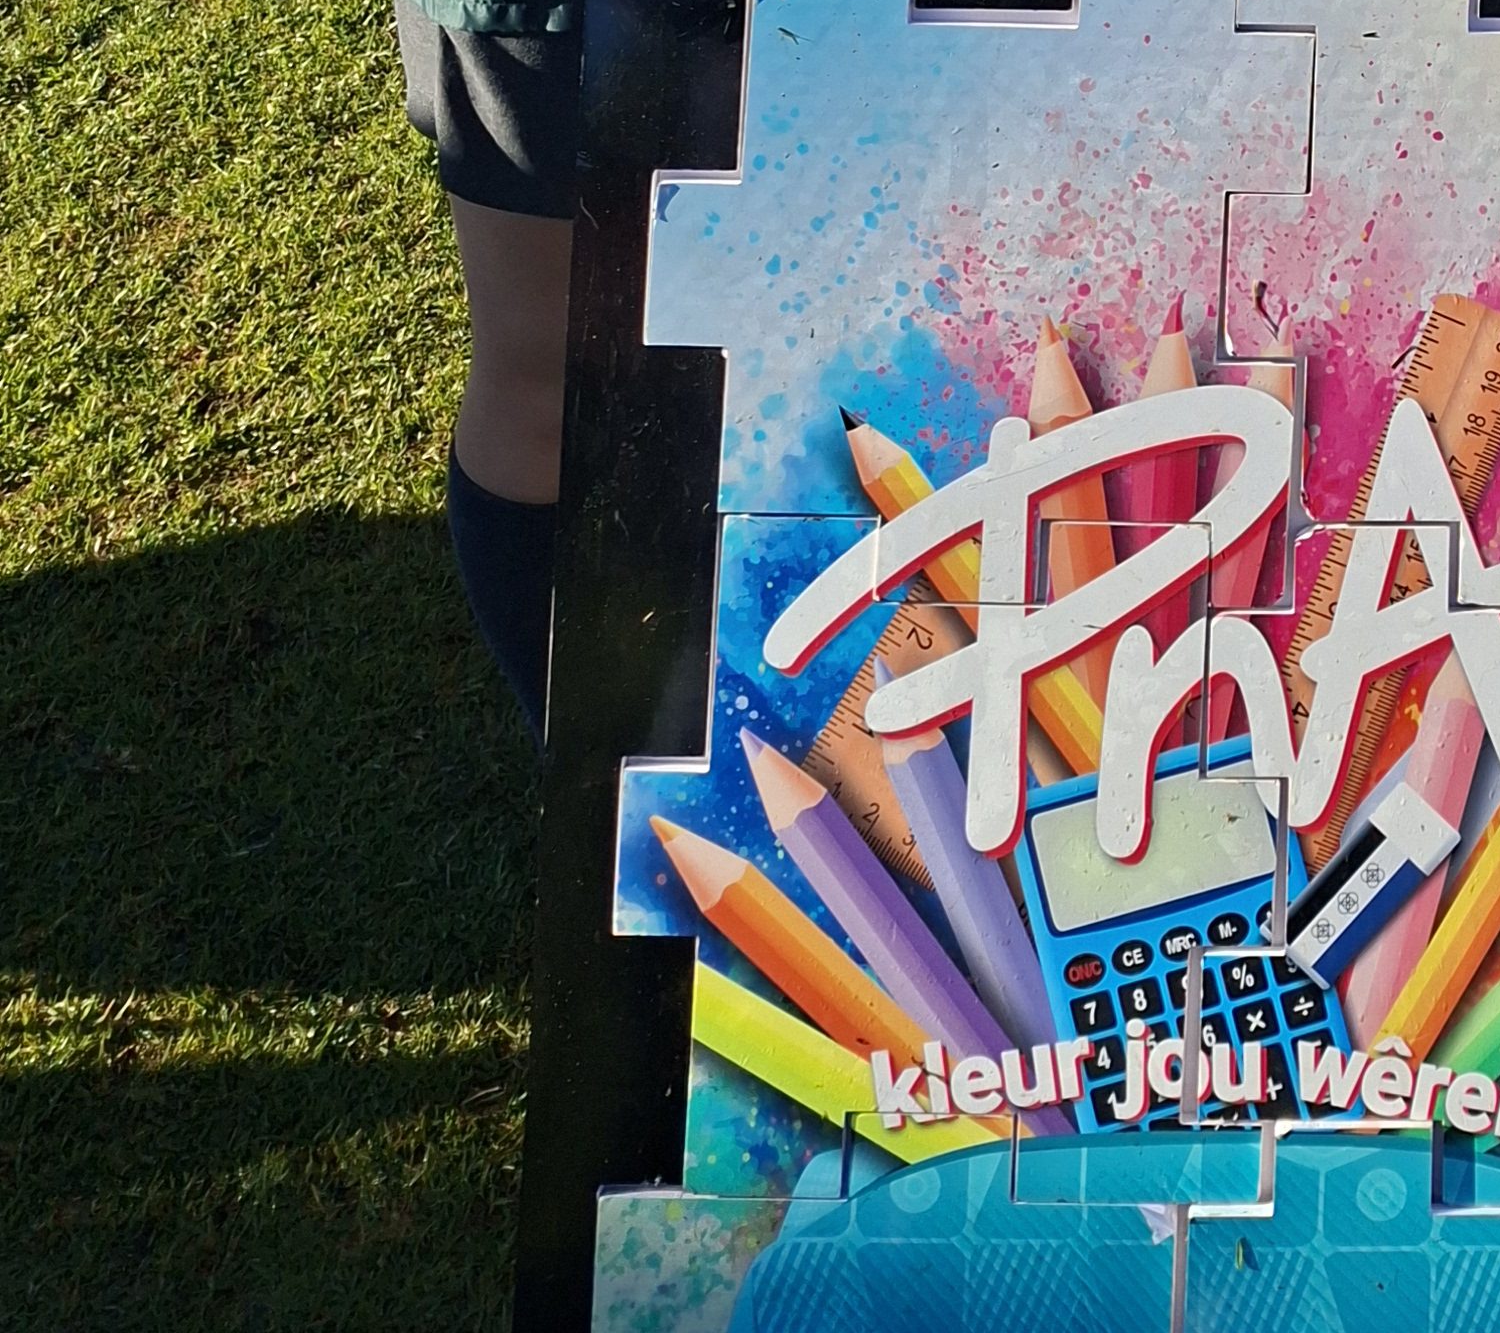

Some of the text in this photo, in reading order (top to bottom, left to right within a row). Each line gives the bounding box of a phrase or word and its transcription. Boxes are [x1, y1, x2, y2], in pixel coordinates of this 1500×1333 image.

[1463, 413, 1487, 436] 18
[862, 802, 880, 823] 2
[1218, 920, 1238, 939] M-
[1165, 933, 1197, 955] MRC
[1122, 948, 1145, 967] CE
[1132, 988, 1148, 1012] 8
[1083, 1000, 1098, 1025] 7
[1202, 1024, 1217, 1047] 6
[1097, 1046, 1112, 1069] 4
[871, 1036, 1093, 1130] kleur
[1110, 1018, 1268, 1121] jou
